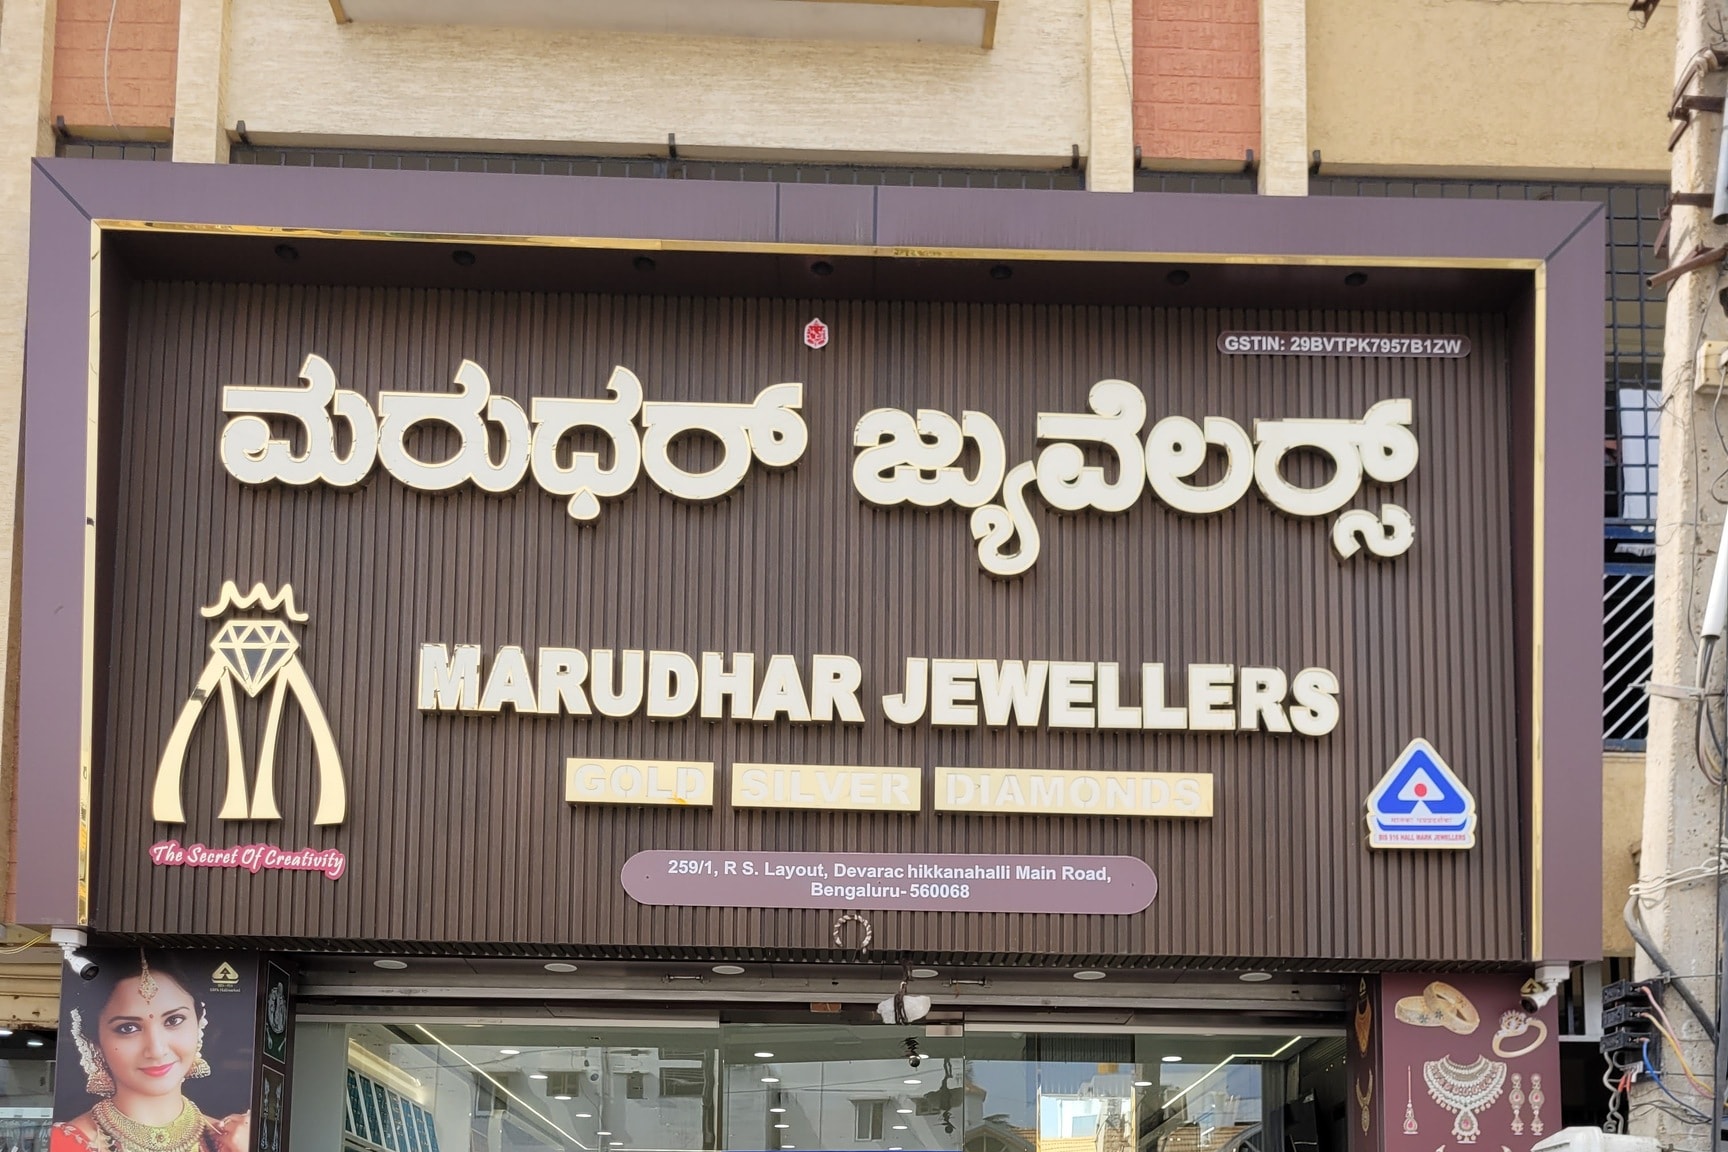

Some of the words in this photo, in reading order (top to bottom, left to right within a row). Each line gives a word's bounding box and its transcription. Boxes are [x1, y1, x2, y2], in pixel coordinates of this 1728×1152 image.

[1224, 335, 1286, 352] GSTIN:
[1290, 336, 1462, 354] 29BVTPK7957B1ZW
[417, 642, 865, 722] MARUDHAR
[882, 657, 1340, 736] JEWELLERS
[574, 764, 706, 800] GOLD
[740, 769, 912, 806] SILVER
[946, 772, 1202, 811] DIAMONDS
[153, 844, 183, 863] The
[187, 847, 239, 865] Secret
[242, 846, 265, 870] Of
[264, 849, 345, 876] Creativity
[667, 860, 718, 877] 259/1,
[724, 861, 737, 875] R
[742, 861, 758, 876] S.
[764, 862, 828, 880] Layout,
[1015, 866, 1056, 881] Main
[1062, 866, 1112, 883] Road,
[910, 884, 970, 898] 560068
